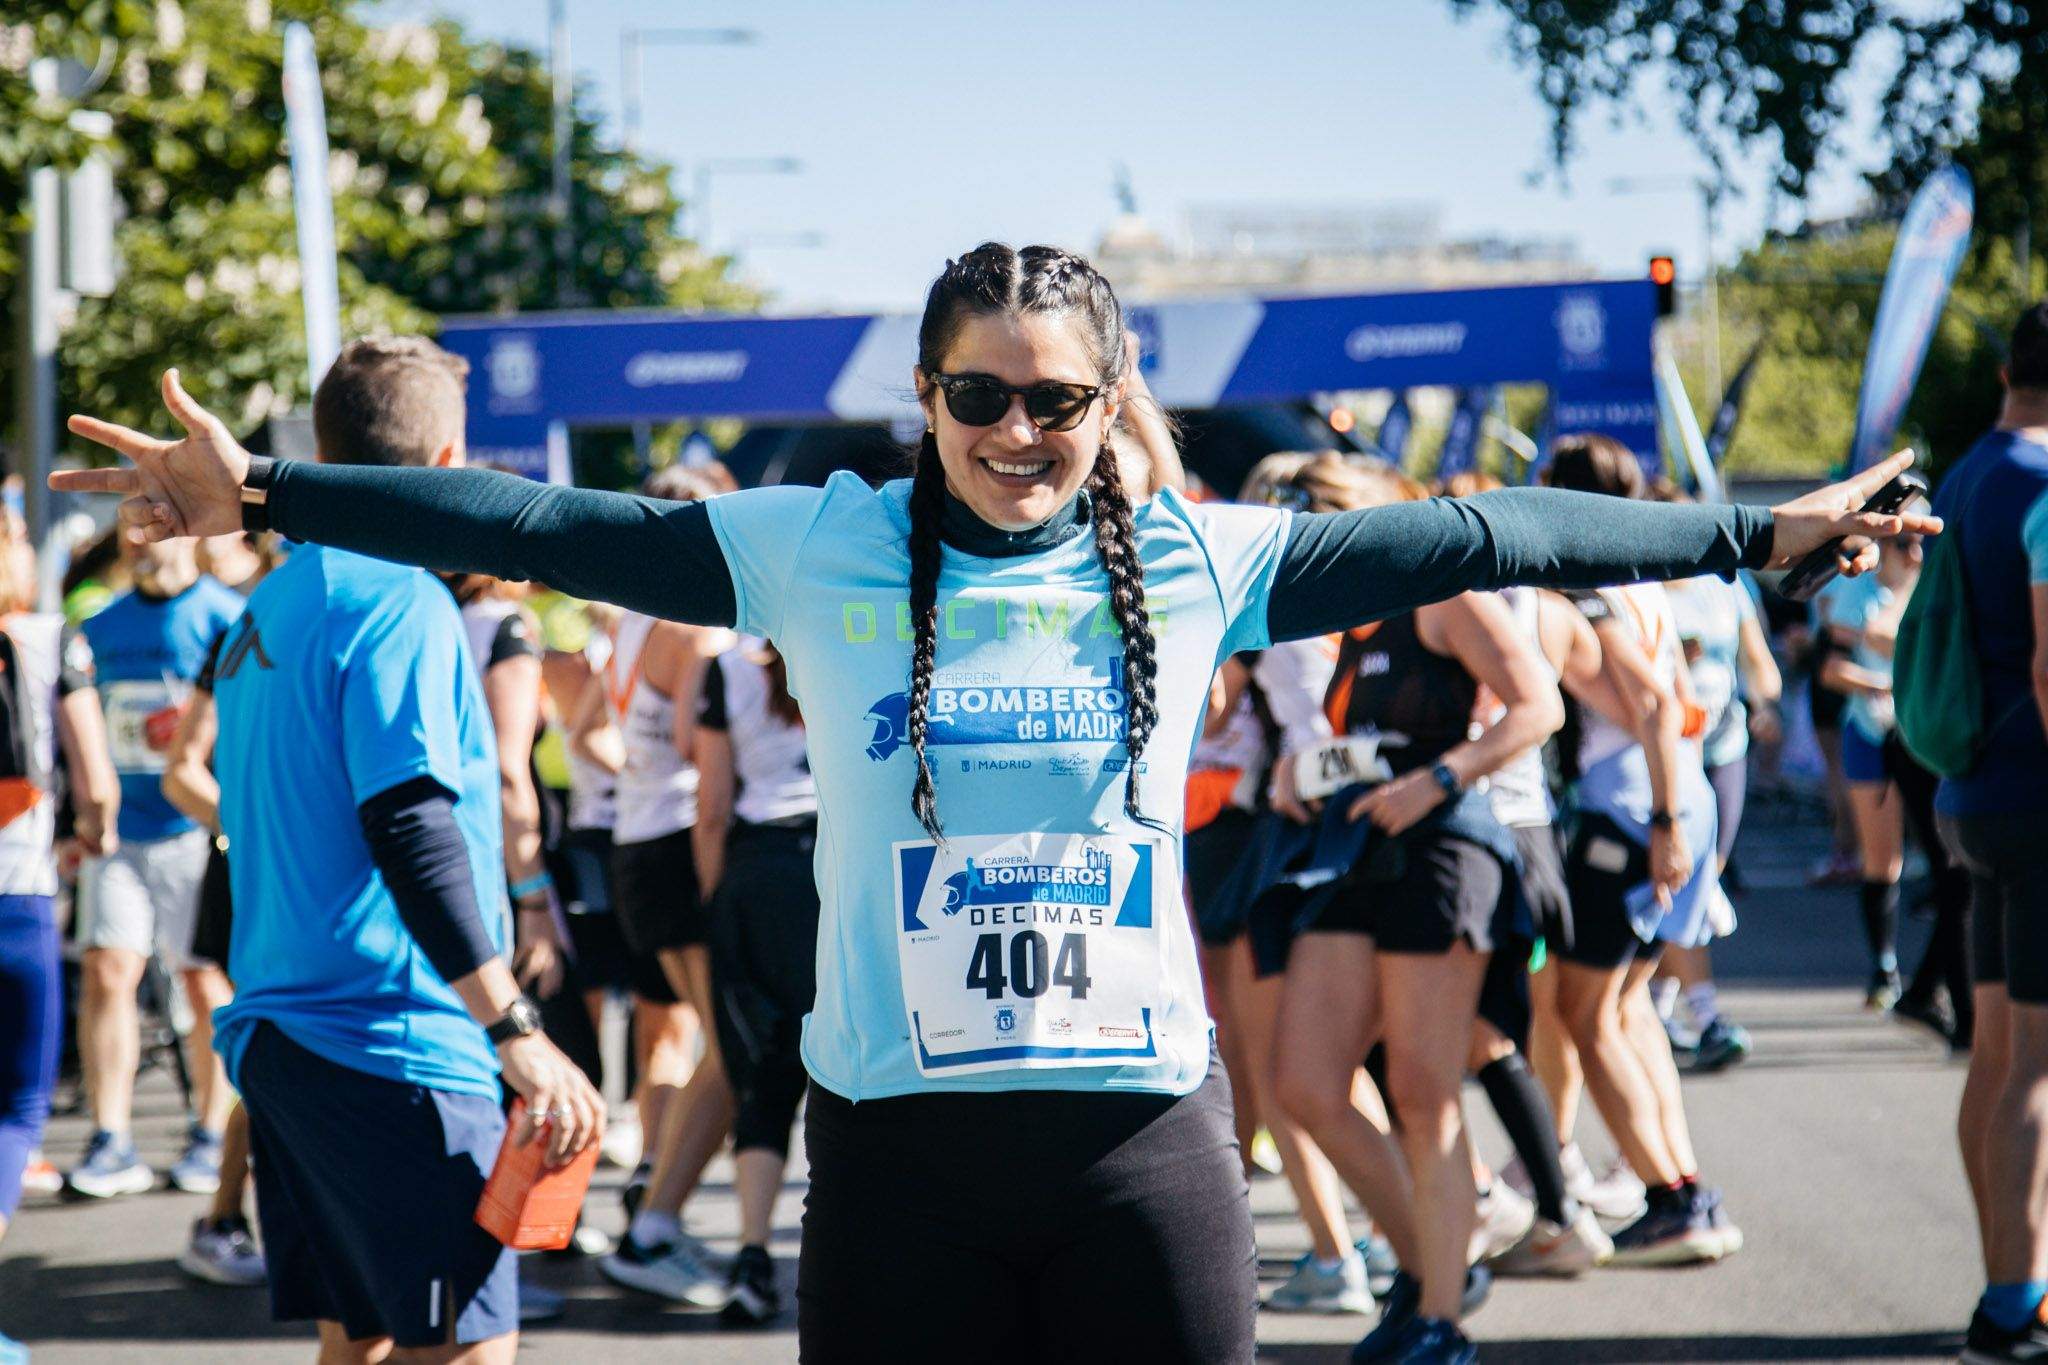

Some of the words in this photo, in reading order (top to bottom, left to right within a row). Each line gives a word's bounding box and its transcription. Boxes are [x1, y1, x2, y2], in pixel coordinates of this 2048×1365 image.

[936, 672, 1001, 685] CARRERA
[936, 688, 1125, 713] BOMBERO
[1017, 713, 1047, 740] de
[1055, 712, 1125, 740] MADR
[978, 759, 1032, 771] MADRID
[984, 856, 1030, 867] CARRERA
[983, 867, 1107, 886] BOMBEROS
[1053, 884, 1107, 904] MADRID
[970, 905, 1103, 926] DECIMAS
[966, 930, 1092, 1000] 404
